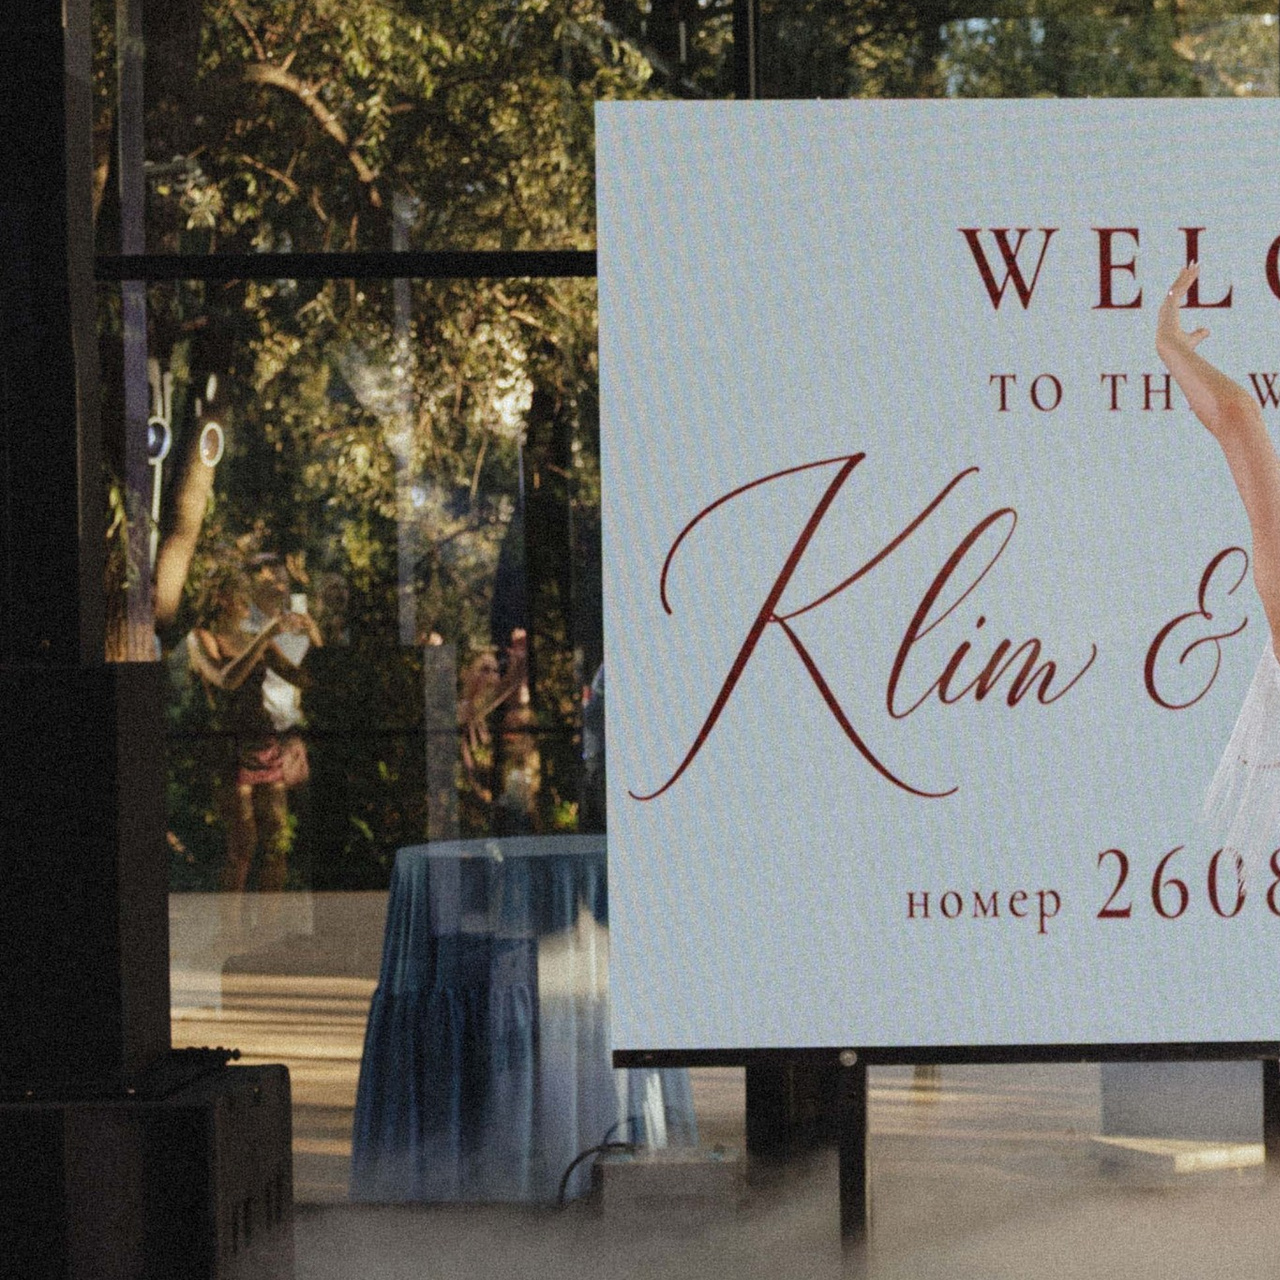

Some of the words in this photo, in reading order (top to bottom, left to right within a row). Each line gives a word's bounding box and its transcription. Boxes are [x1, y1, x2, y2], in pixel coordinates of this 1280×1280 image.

[989, 373, 1063, 412] TO
[1101, 373, 1194, 411] TH
[628, 451, 1098, 801] Klim
[1143, 546, 1249, 710] &
[906, 889, 1061, 934] номер
